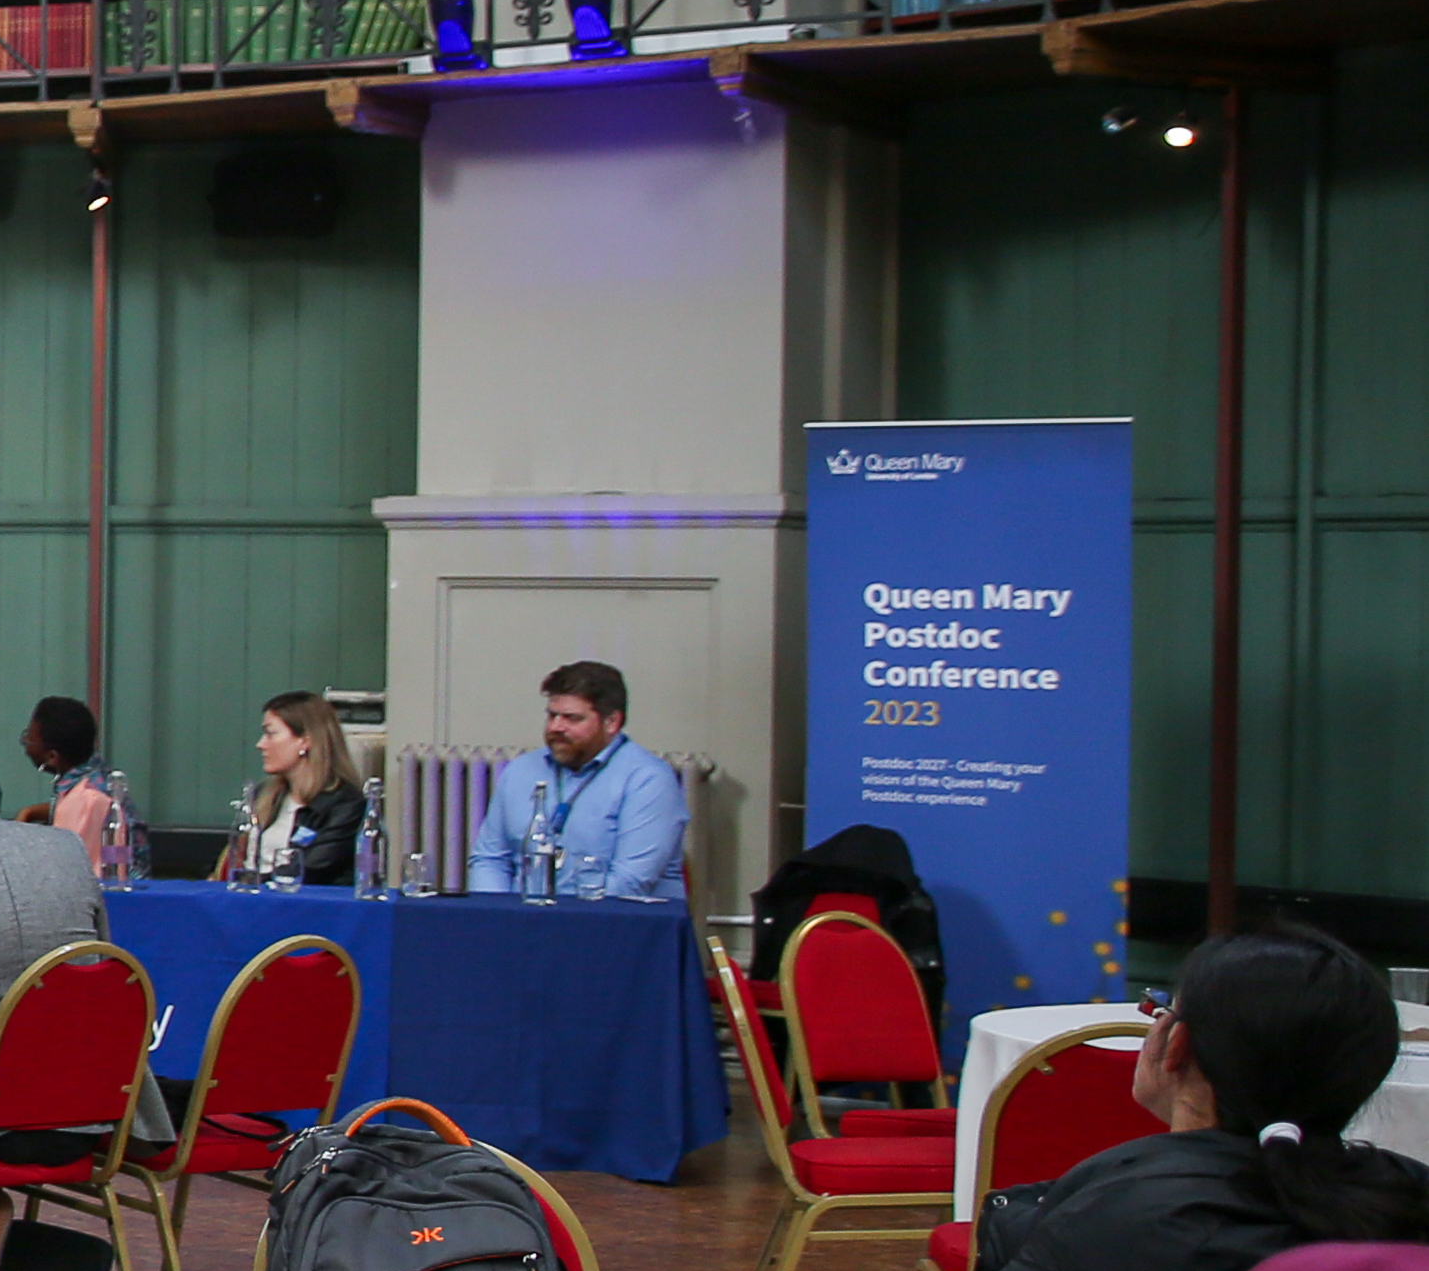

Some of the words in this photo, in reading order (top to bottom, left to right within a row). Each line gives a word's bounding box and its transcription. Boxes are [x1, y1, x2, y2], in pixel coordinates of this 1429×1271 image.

[865, 454, 920, 471] Queen
[922, 453, 966, 473] Mary
[864, 583, 974, 615] Queen
[983, 584, 1073, 617] Mary
[865, 622, 1001, 649] Postdoc
[864, 660, 1060, 690] Conference
[864, 700, 941, 726] 2023
[861, 755, 914, 772] Postdoc
[915, 758, 946, 771] 2027
[956, 758, 1012, 775] Creating
[1013, 763, 1047, 775] your
[861, 773, 899, 787] vision
[902, 774, 917, 786] of
[918, 775, 939, 788] the
[940, 776, 985, 791] Queen
[987, 778, 1022, 793] Mary
[861, 790, 914, 804] Postdoc
[915, 791, 987, 807] experience
